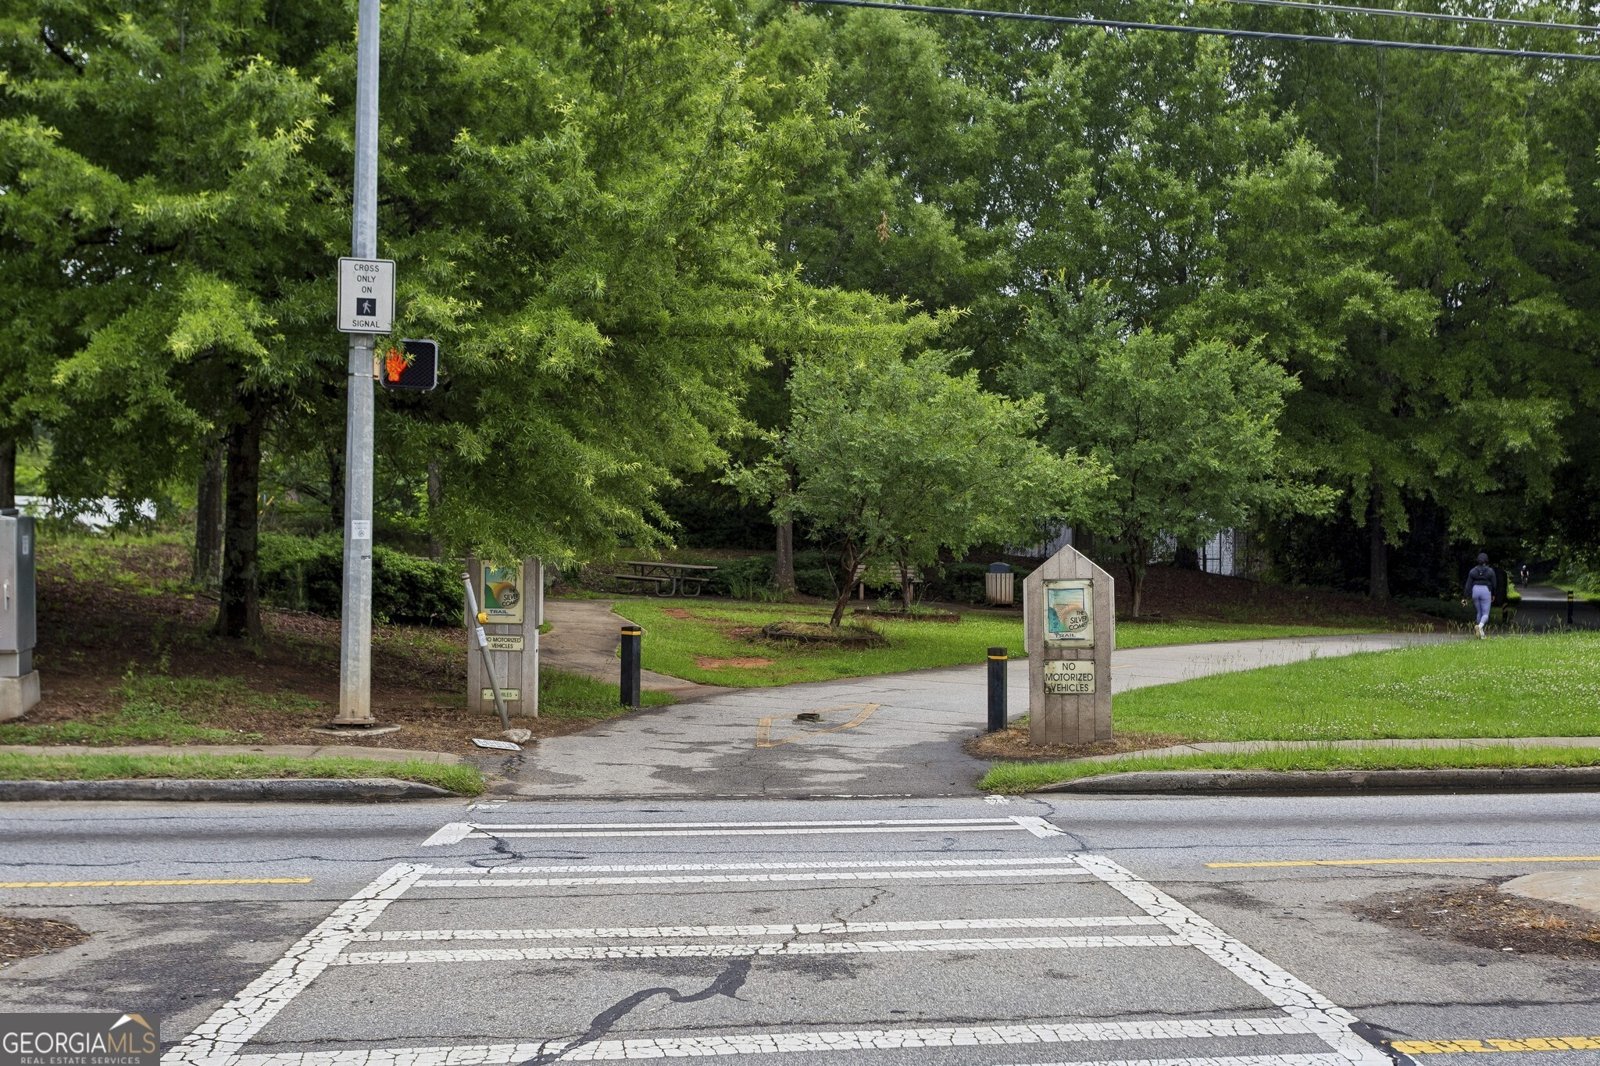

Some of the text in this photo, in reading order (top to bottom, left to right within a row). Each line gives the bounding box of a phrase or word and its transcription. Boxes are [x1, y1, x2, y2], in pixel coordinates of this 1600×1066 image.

[354, 264, 380, 272] CROSS
[357, 275, 376, 283] ONLY
[352, 320, 380, 328] SIGNAL
[1062, 662, 1076, 671] NO
[1045, 673, 1094, 682] MOTORIZED
[1050, 684, 1089, 692] VEHICLES
